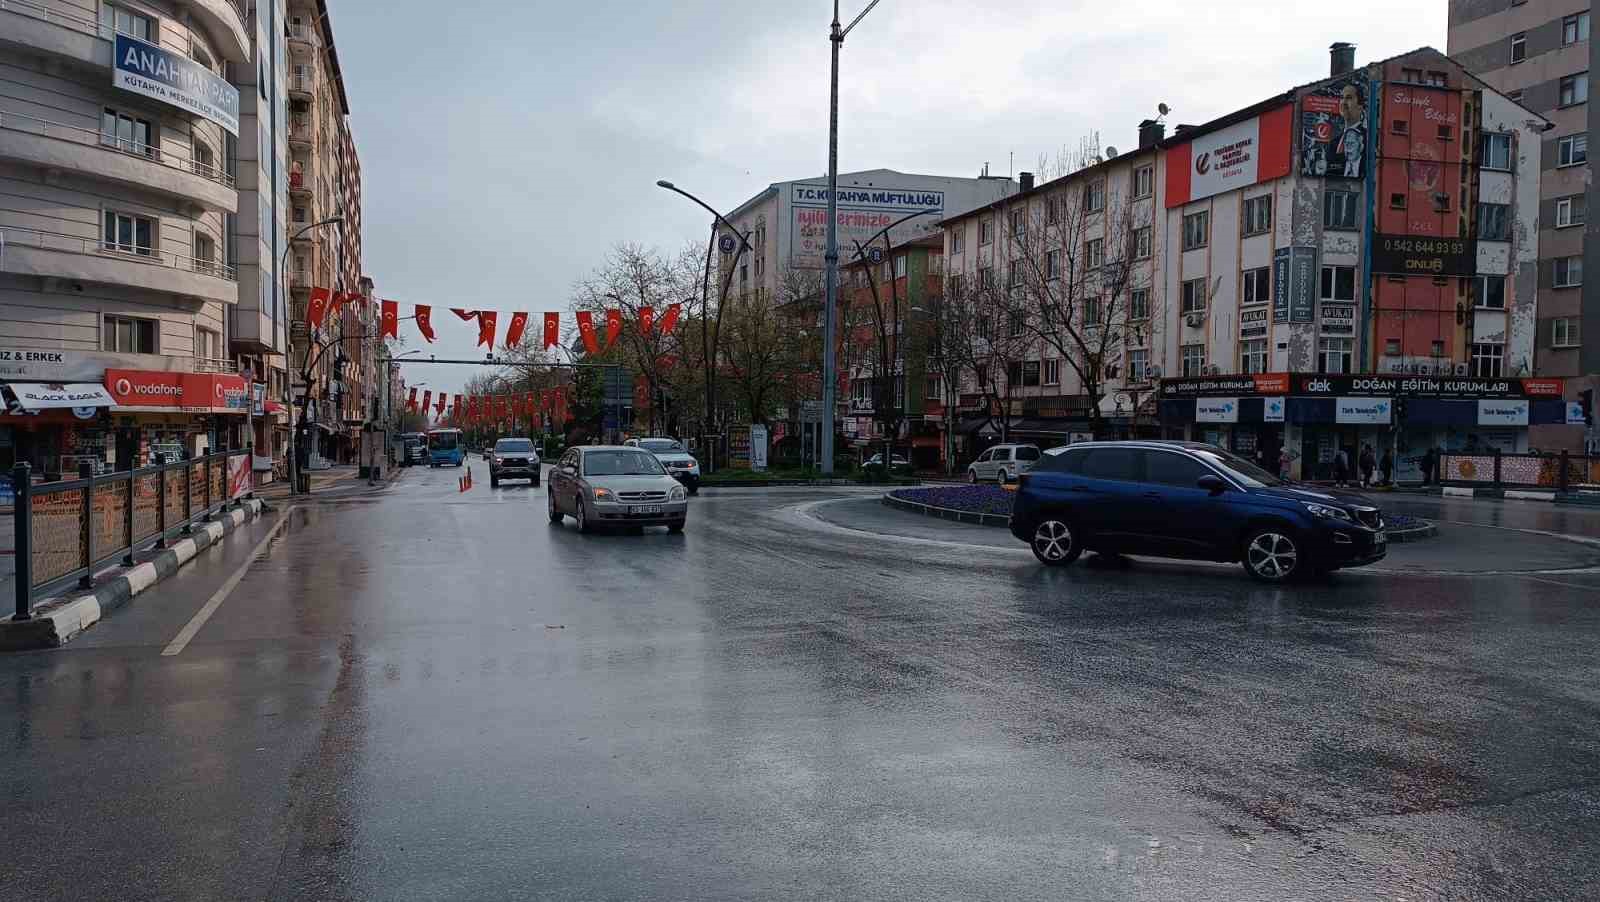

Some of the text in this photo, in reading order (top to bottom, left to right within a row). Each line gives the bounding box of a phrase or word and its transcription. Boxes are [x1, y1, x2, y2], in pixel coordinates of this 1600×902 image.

[124, 75, 166, 97] KÜTAHYA
[1394, 239, 1412, 252] 542
[1416, 241, 1434, 254] 644
[26, 352, 62, 362] ERKEK
[134, 382, 183, 396] vodafone
[1308, 378, 1331, 392] dek
[1353, 378, 1509, 392] DOĞAN EĞİTİM KURUMLARI
[24, 391, 103, 401] BLACK EAGLE
